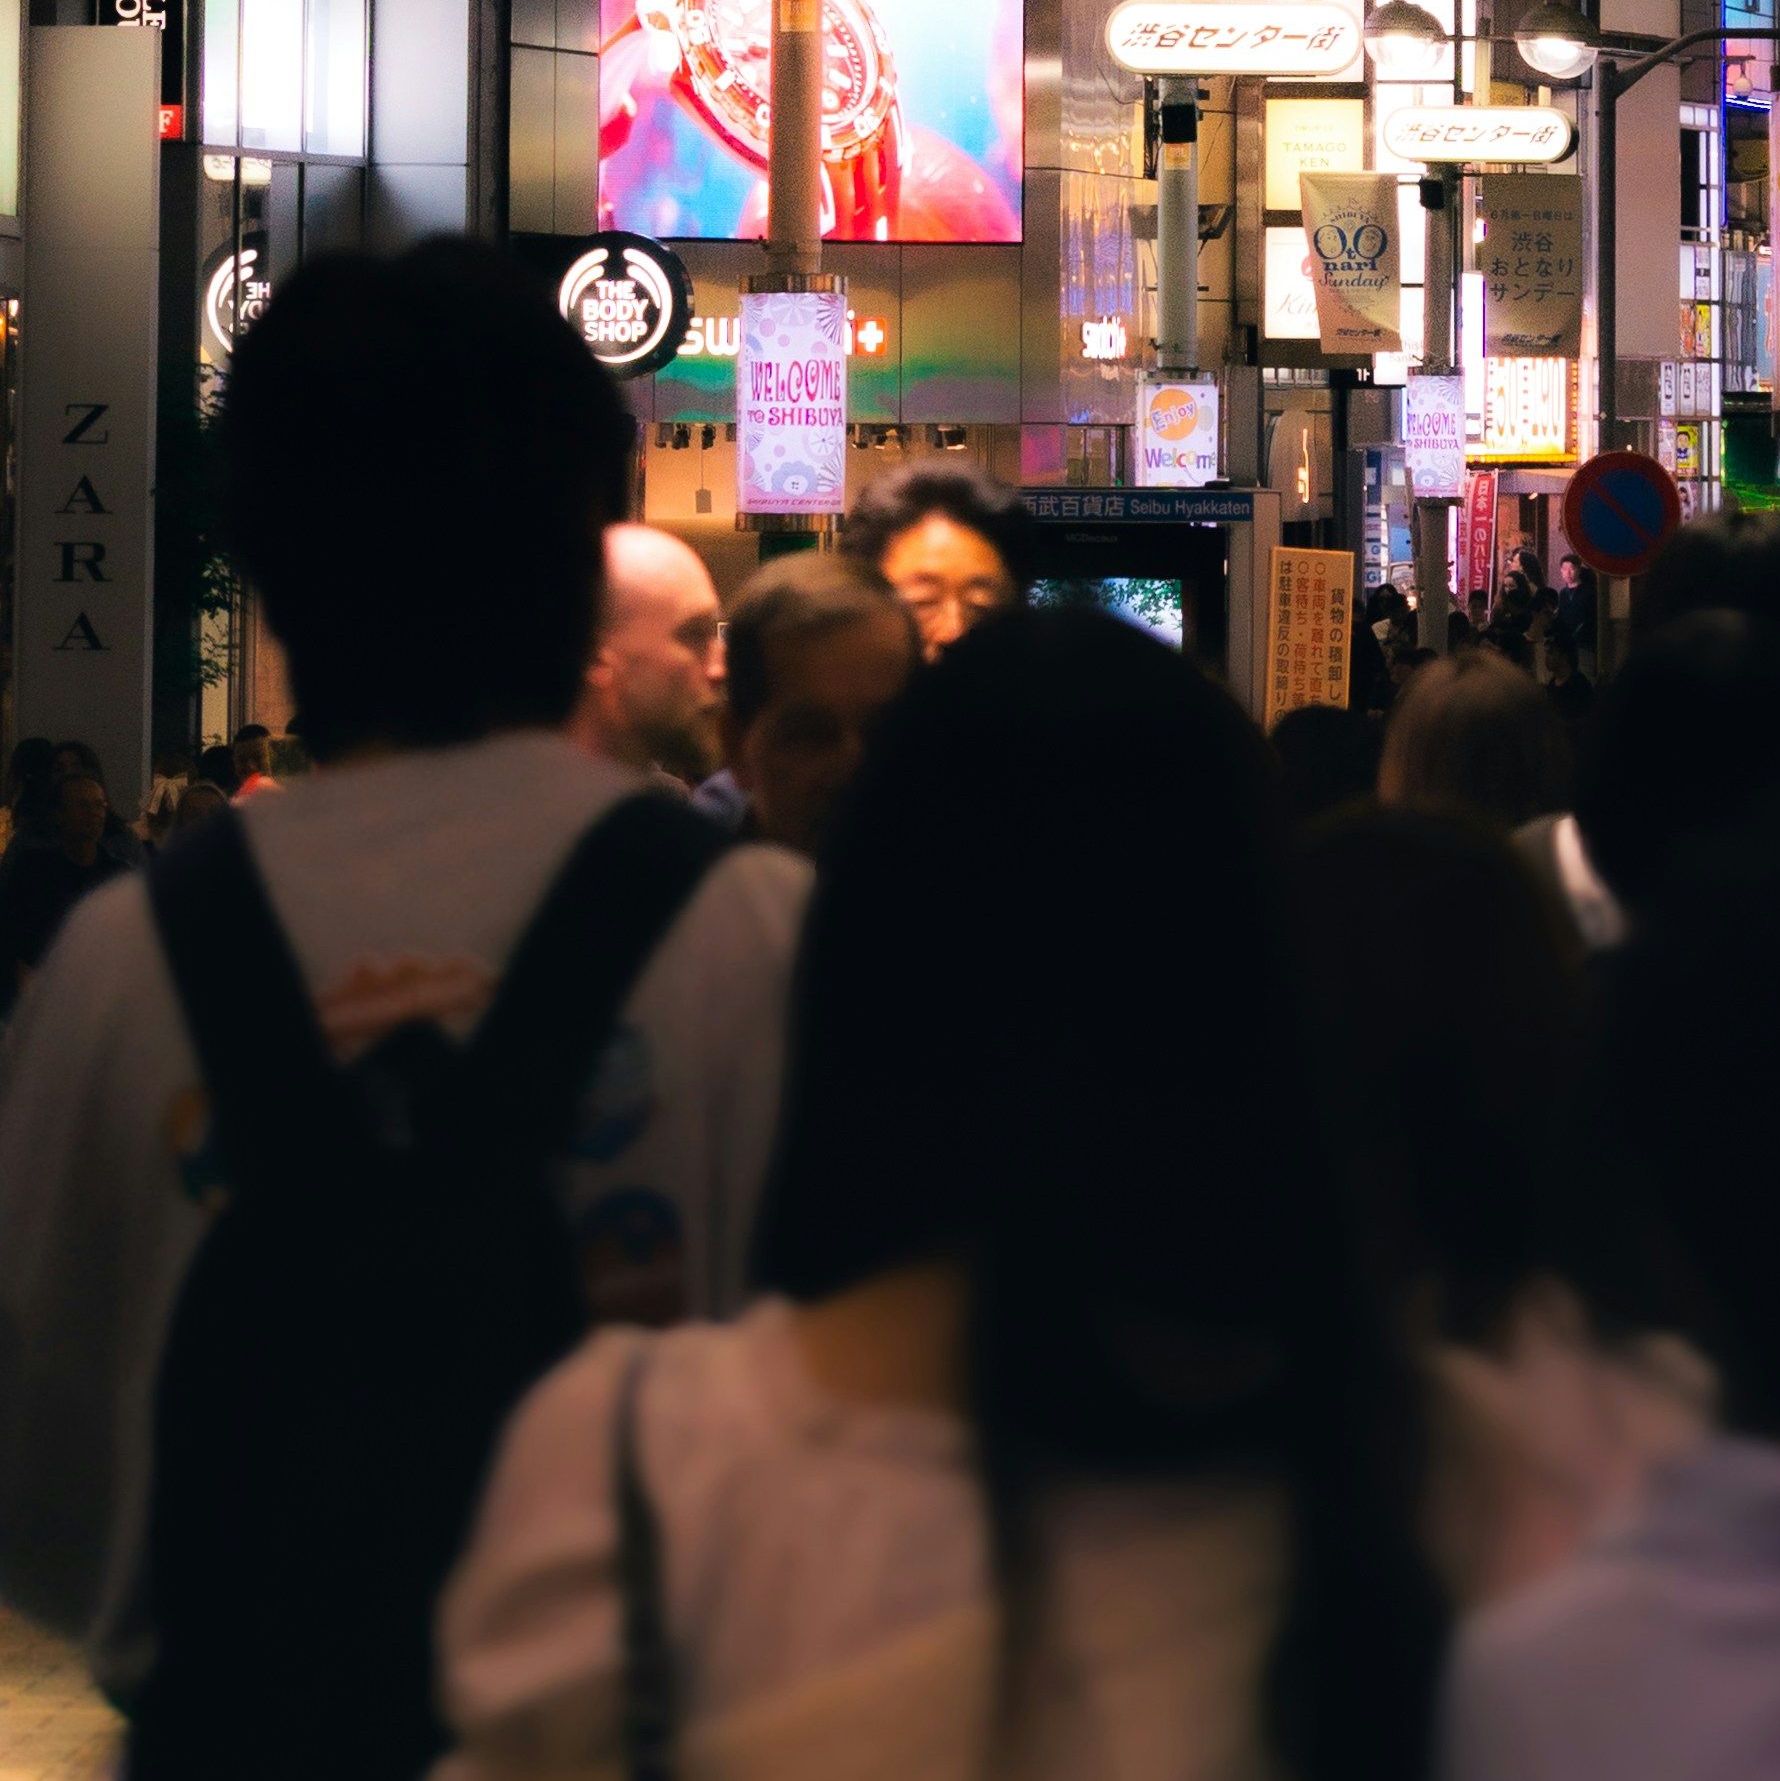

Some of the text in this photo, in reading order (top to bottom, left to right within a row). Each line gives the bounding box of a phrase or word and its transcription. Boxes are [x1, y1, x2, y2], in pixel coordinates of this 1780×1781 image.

[1120, 22, 1346, 51] 渋谷センター街
[1395, 123, 1559, 145] 渋谷センター街
[1282, 141, 1348, 153] TAMAGO
[1299, 158, 1330, 168] KEN
[1509, 230, 1554, 253] 渋谷
[1322, 259, 1378, 273] nari
[1490, 257, 1575, 277] おとなり
[596, 281, 637, 300] THE
[1318, 270, 1391, 291] Sunday
[1490, 281, 1576, 303] サンデー
[582, 300, 649, 322] BODY
[585, 322, 649, 343] SHOP
[750, 359, 842, 404] WELCOME
[768, 406, 844, 427] SHIBUYA
[1151, 401, 1197, 433] Enjoy
[1413, 438, 1461, 450] SHIBUYA
[1130, 499, 1250, 519] Seibu Hyakkaten
[52, 401, 114, 653] ZARA
[1327, 588, 1346, 708] 貨物の積卸し
